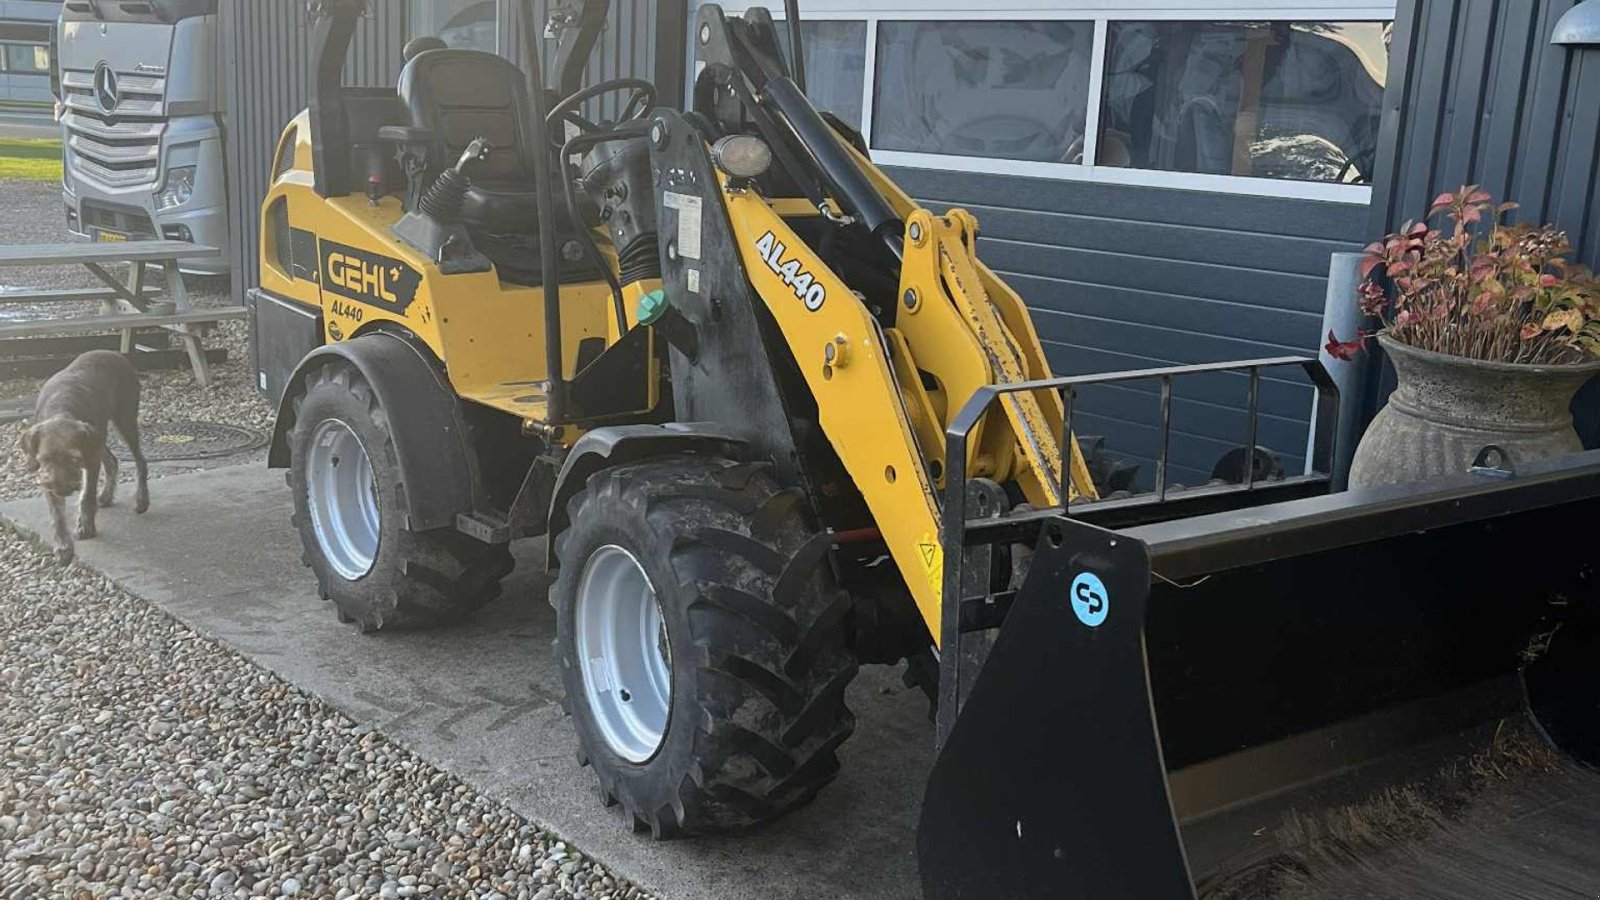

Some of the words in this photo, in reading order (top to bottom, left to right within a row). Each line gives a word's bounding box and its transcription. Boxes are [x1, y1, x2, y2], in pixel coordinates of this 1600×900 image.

[328, 252, 397, 303] GEHL
[755, 230, 827, 312] AL440
[331, 300, 363, 322] AL440
